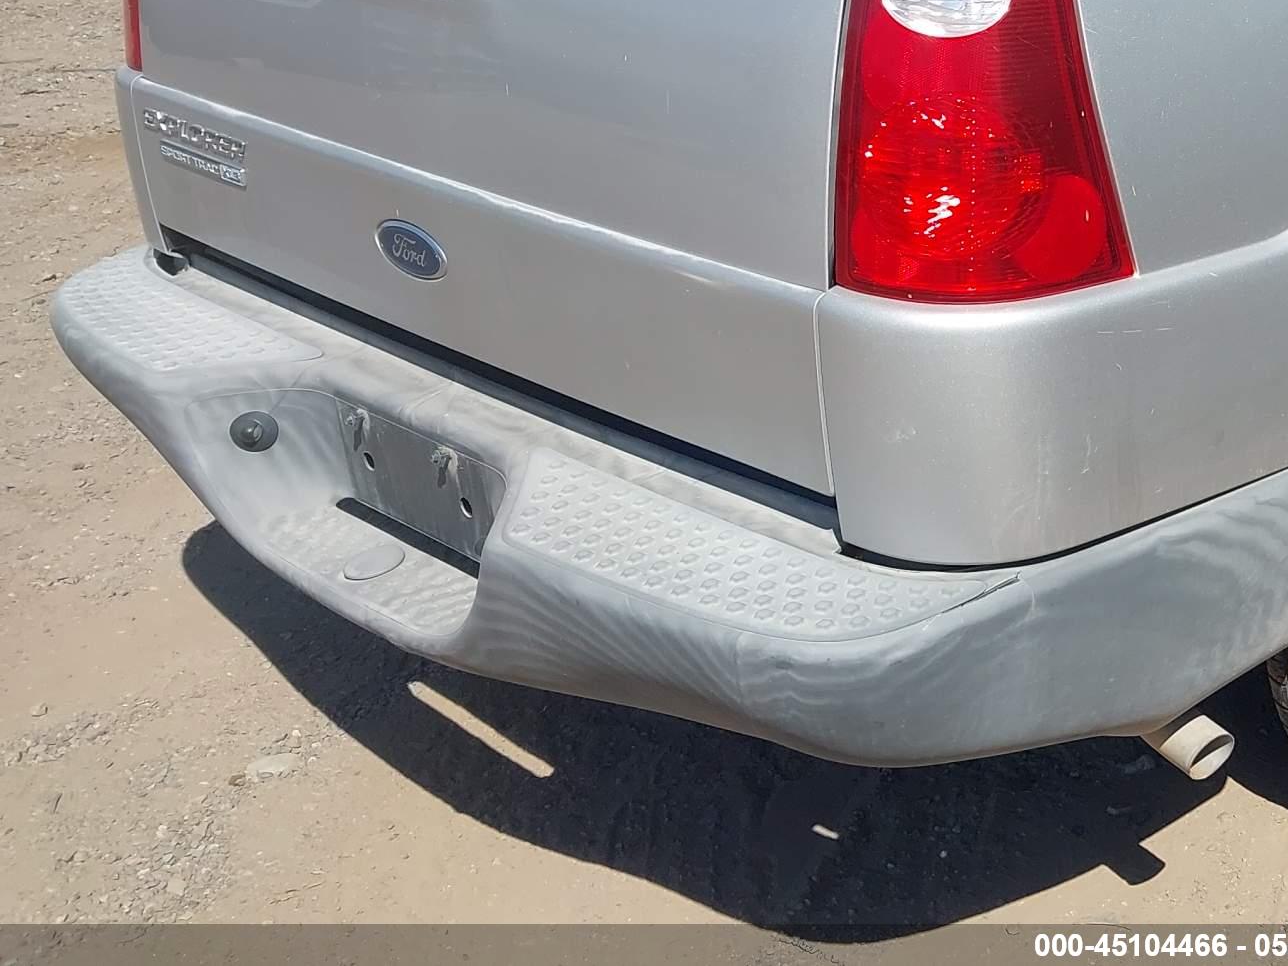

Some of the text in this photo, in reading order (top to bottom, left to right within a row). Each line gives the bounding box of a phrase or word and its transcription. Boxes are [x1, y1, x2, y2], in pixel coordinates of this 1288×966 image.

[143, 107, 246, 162] EXPLORER
[159, 145, 192, 166] SPORT
[190, 155, 220, 176] TRAC
[392, 233, 426, 267] Ford
